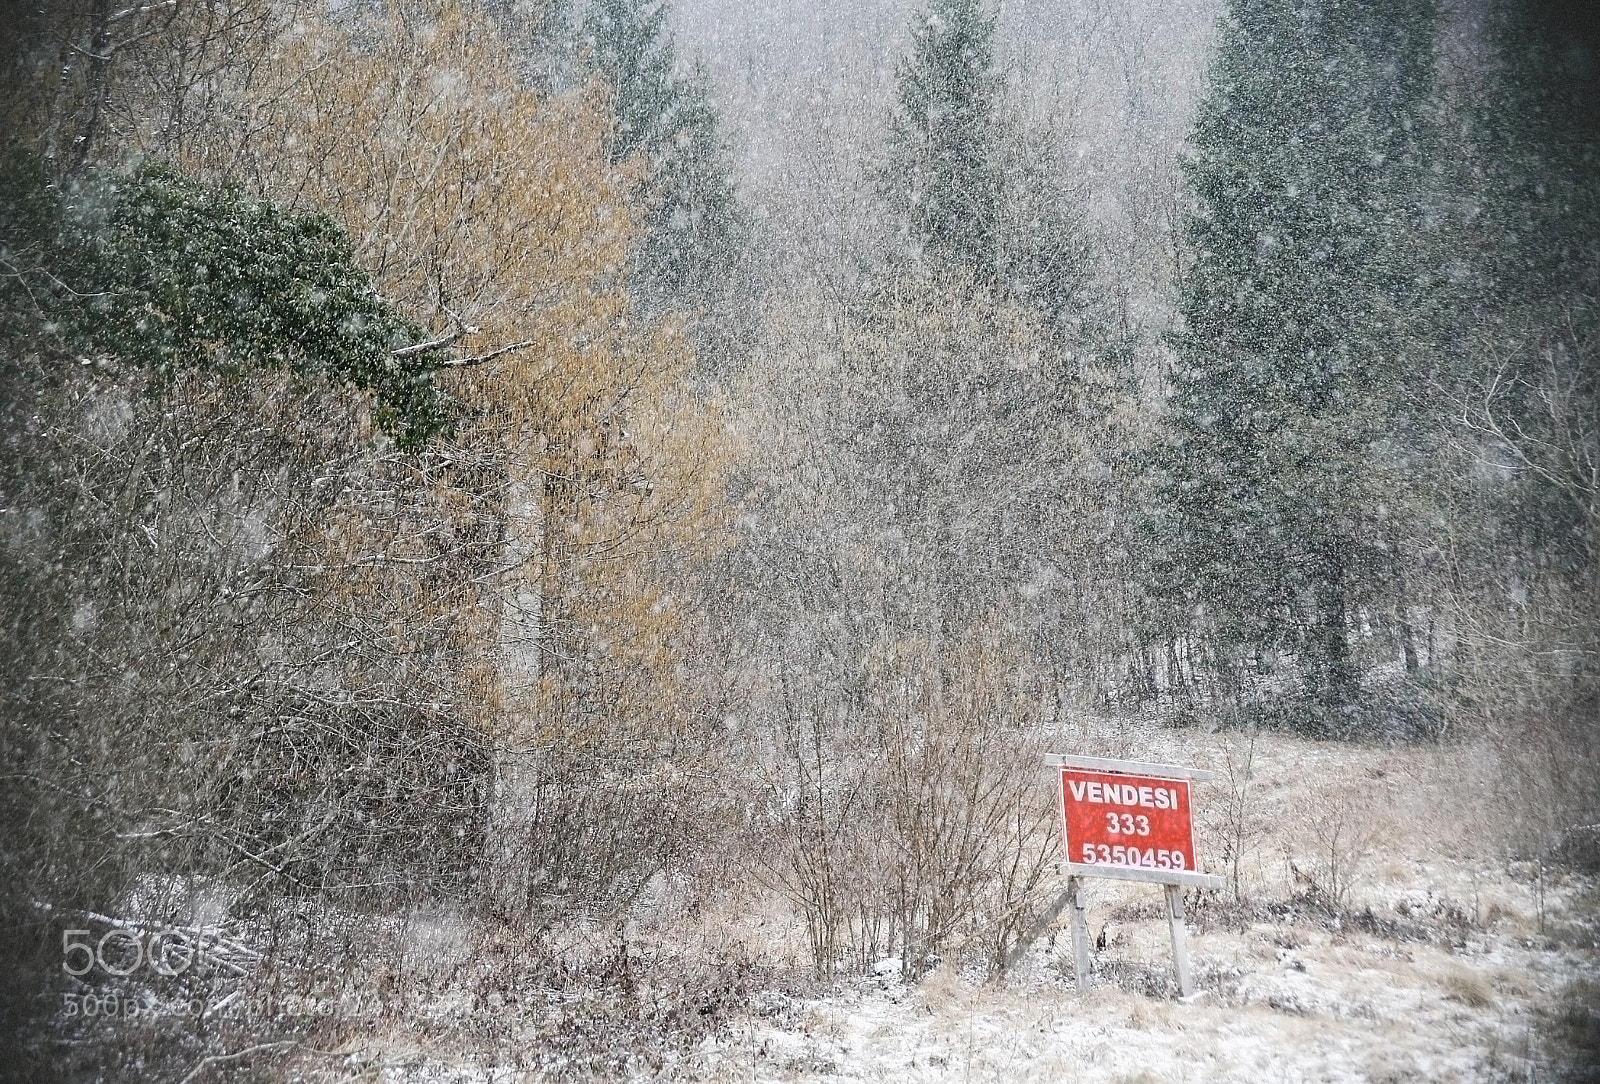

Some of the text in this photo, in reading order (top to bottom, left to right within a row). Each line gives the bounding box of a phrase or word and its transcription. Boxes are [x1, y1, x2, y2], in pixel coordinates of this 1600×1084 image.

[1068, 780, 1178, 809] VENDESI
[1106, 812, 1150, 836] 333
[1082, 843, 1186, 871] 5350459
